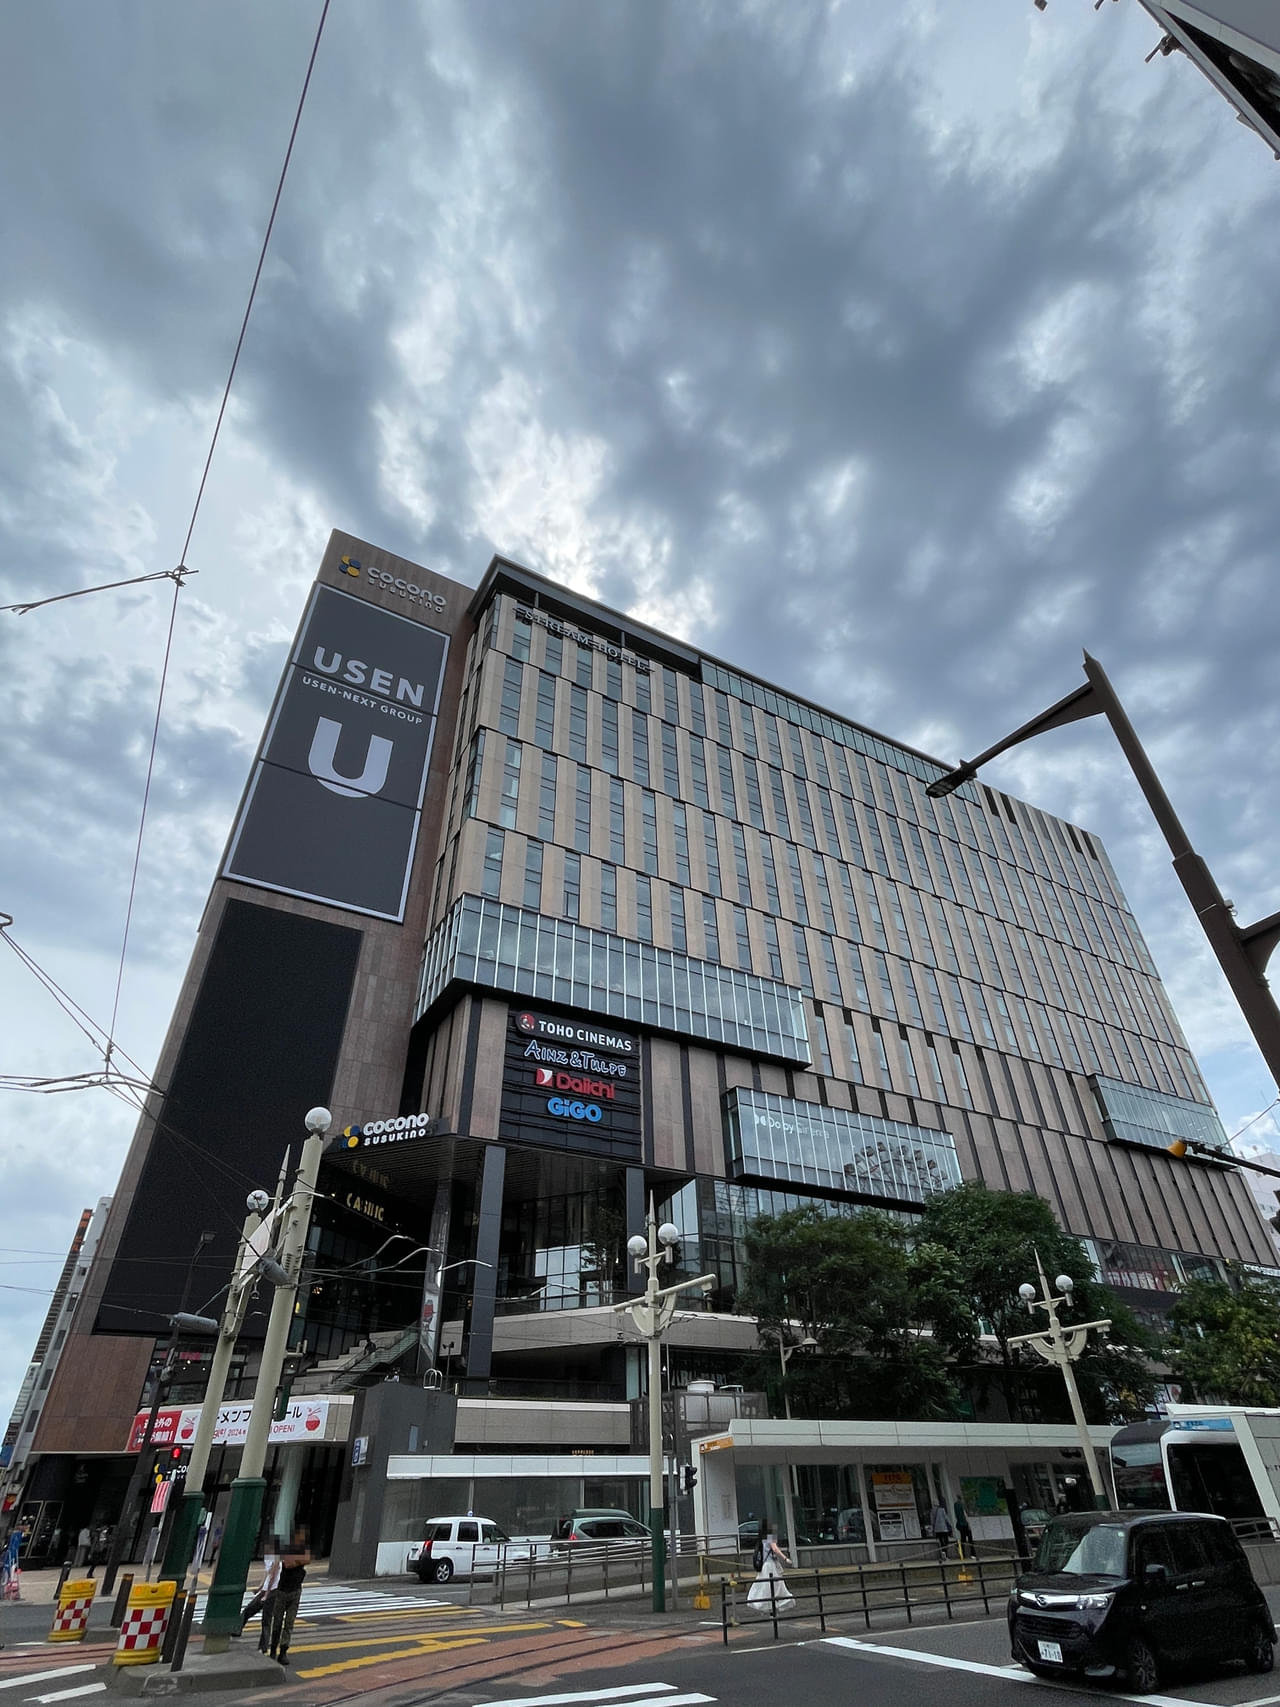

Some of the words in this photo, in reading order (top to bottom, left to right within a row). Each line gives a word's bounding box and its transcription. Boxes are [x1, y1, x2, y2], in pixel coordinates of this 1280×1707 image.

[313, 646, 425, 707] USEN
[302, 676, 377, 709] USEN-NEXT
[380, 704, 424, 725] GROUP
[538, 1020, 574, 1038] TOHO
[576, 1029, 632, 1051] CINEMAS
[555, 1072, 615, 1099] Daiichi
[547, 1097, 602, 1122] GiGO
[768, 1116, 794, 1134] Doby
